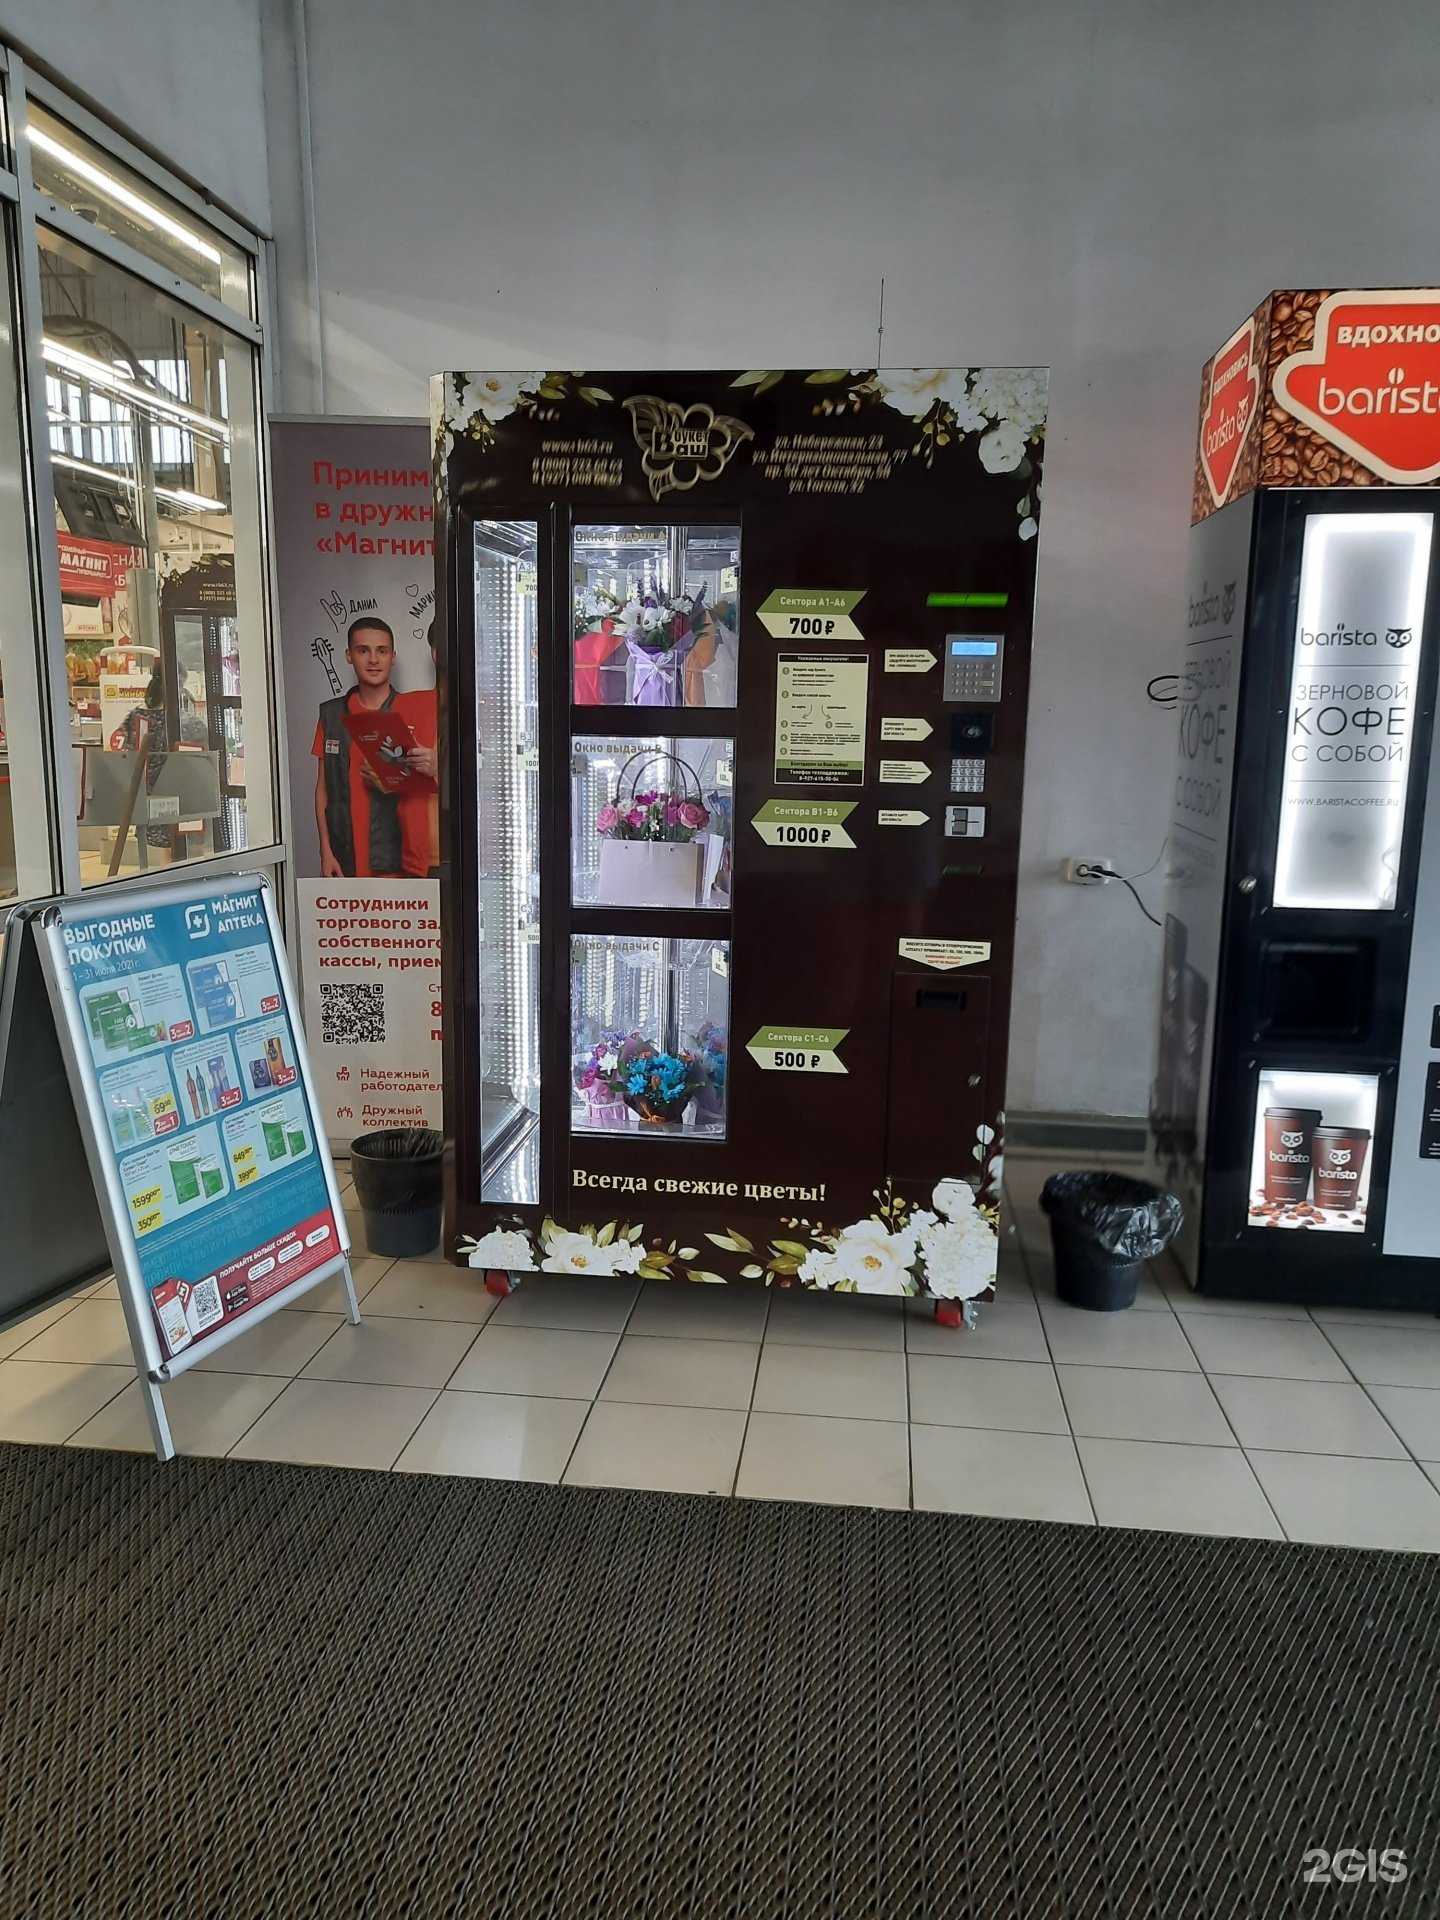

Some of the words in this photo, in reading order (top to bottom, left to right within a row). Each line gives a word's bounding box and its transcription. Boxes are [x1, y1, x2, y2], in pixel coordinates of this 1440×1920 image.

[1318, 367, 1440, 416] barist
[313, 460, 432, 490] Приним
[315, 504, 331, 519] в
[60, 551, 108, 571] МАГНИТ
[349, 598, 377, 613] ДАНИЛ
[779, 595, 817, 608] Сектора
[1300, 623, 1378, 647] barista
[1296, 681, 1409, 702] ЗЕРНОВОЙ
[1292, 706, 1406, 737] КОФЕ
[1178, 703, 1228, 765] КОФЕ
[574, 741, 603, 753] Окно
[606, 743, 652, 756] выдачи
[1291, 746, 1308, 762] С
[1315, 742, 1403, 762] СОБОЙ
[1287, 796, 1399, 808] WWW.BARISTACOFFEE.RU
[774, 806, 811, 817] Сектора
[211, 894, 260, 915] МАГНИТ
[315, 896, 429, 914] Сотрудники
[63, 913, 156, 945] ВЫГОДНЫЕ
[216, 913, 265, 935] АПТЕКА
[316, 917, 412, 932] торгового
[417, 918, 441, 930] за
[67, 935, 147, 965] ПОКУПКИ
[573, 941, 603, 952] Окно
[606, 941, 650, 953] выдачи
[319, 955, 382, 970] кассы,
[431, 1001, 443, 1017] 8
[768, 1032, 803, 1044] Сектора
[774, 1052, 806, 1068] 500
[361, 1068, 430, 1080] Надежный
[361, 1104, 423, 1117] Дружный
[362, 1117, 429, 1127] коллектив
[1269, 1150, 1310, 1164] barista
[1318, 1167, 1358, 1180] barista
[572, 1169, 648, 1193] Всегда
[653, 1177, 738, 1197] свежие
[744, 1183, 826, 1202] цветы!
[219, 1255, 253, 1279] ПОЛУЧАЙТЕ
